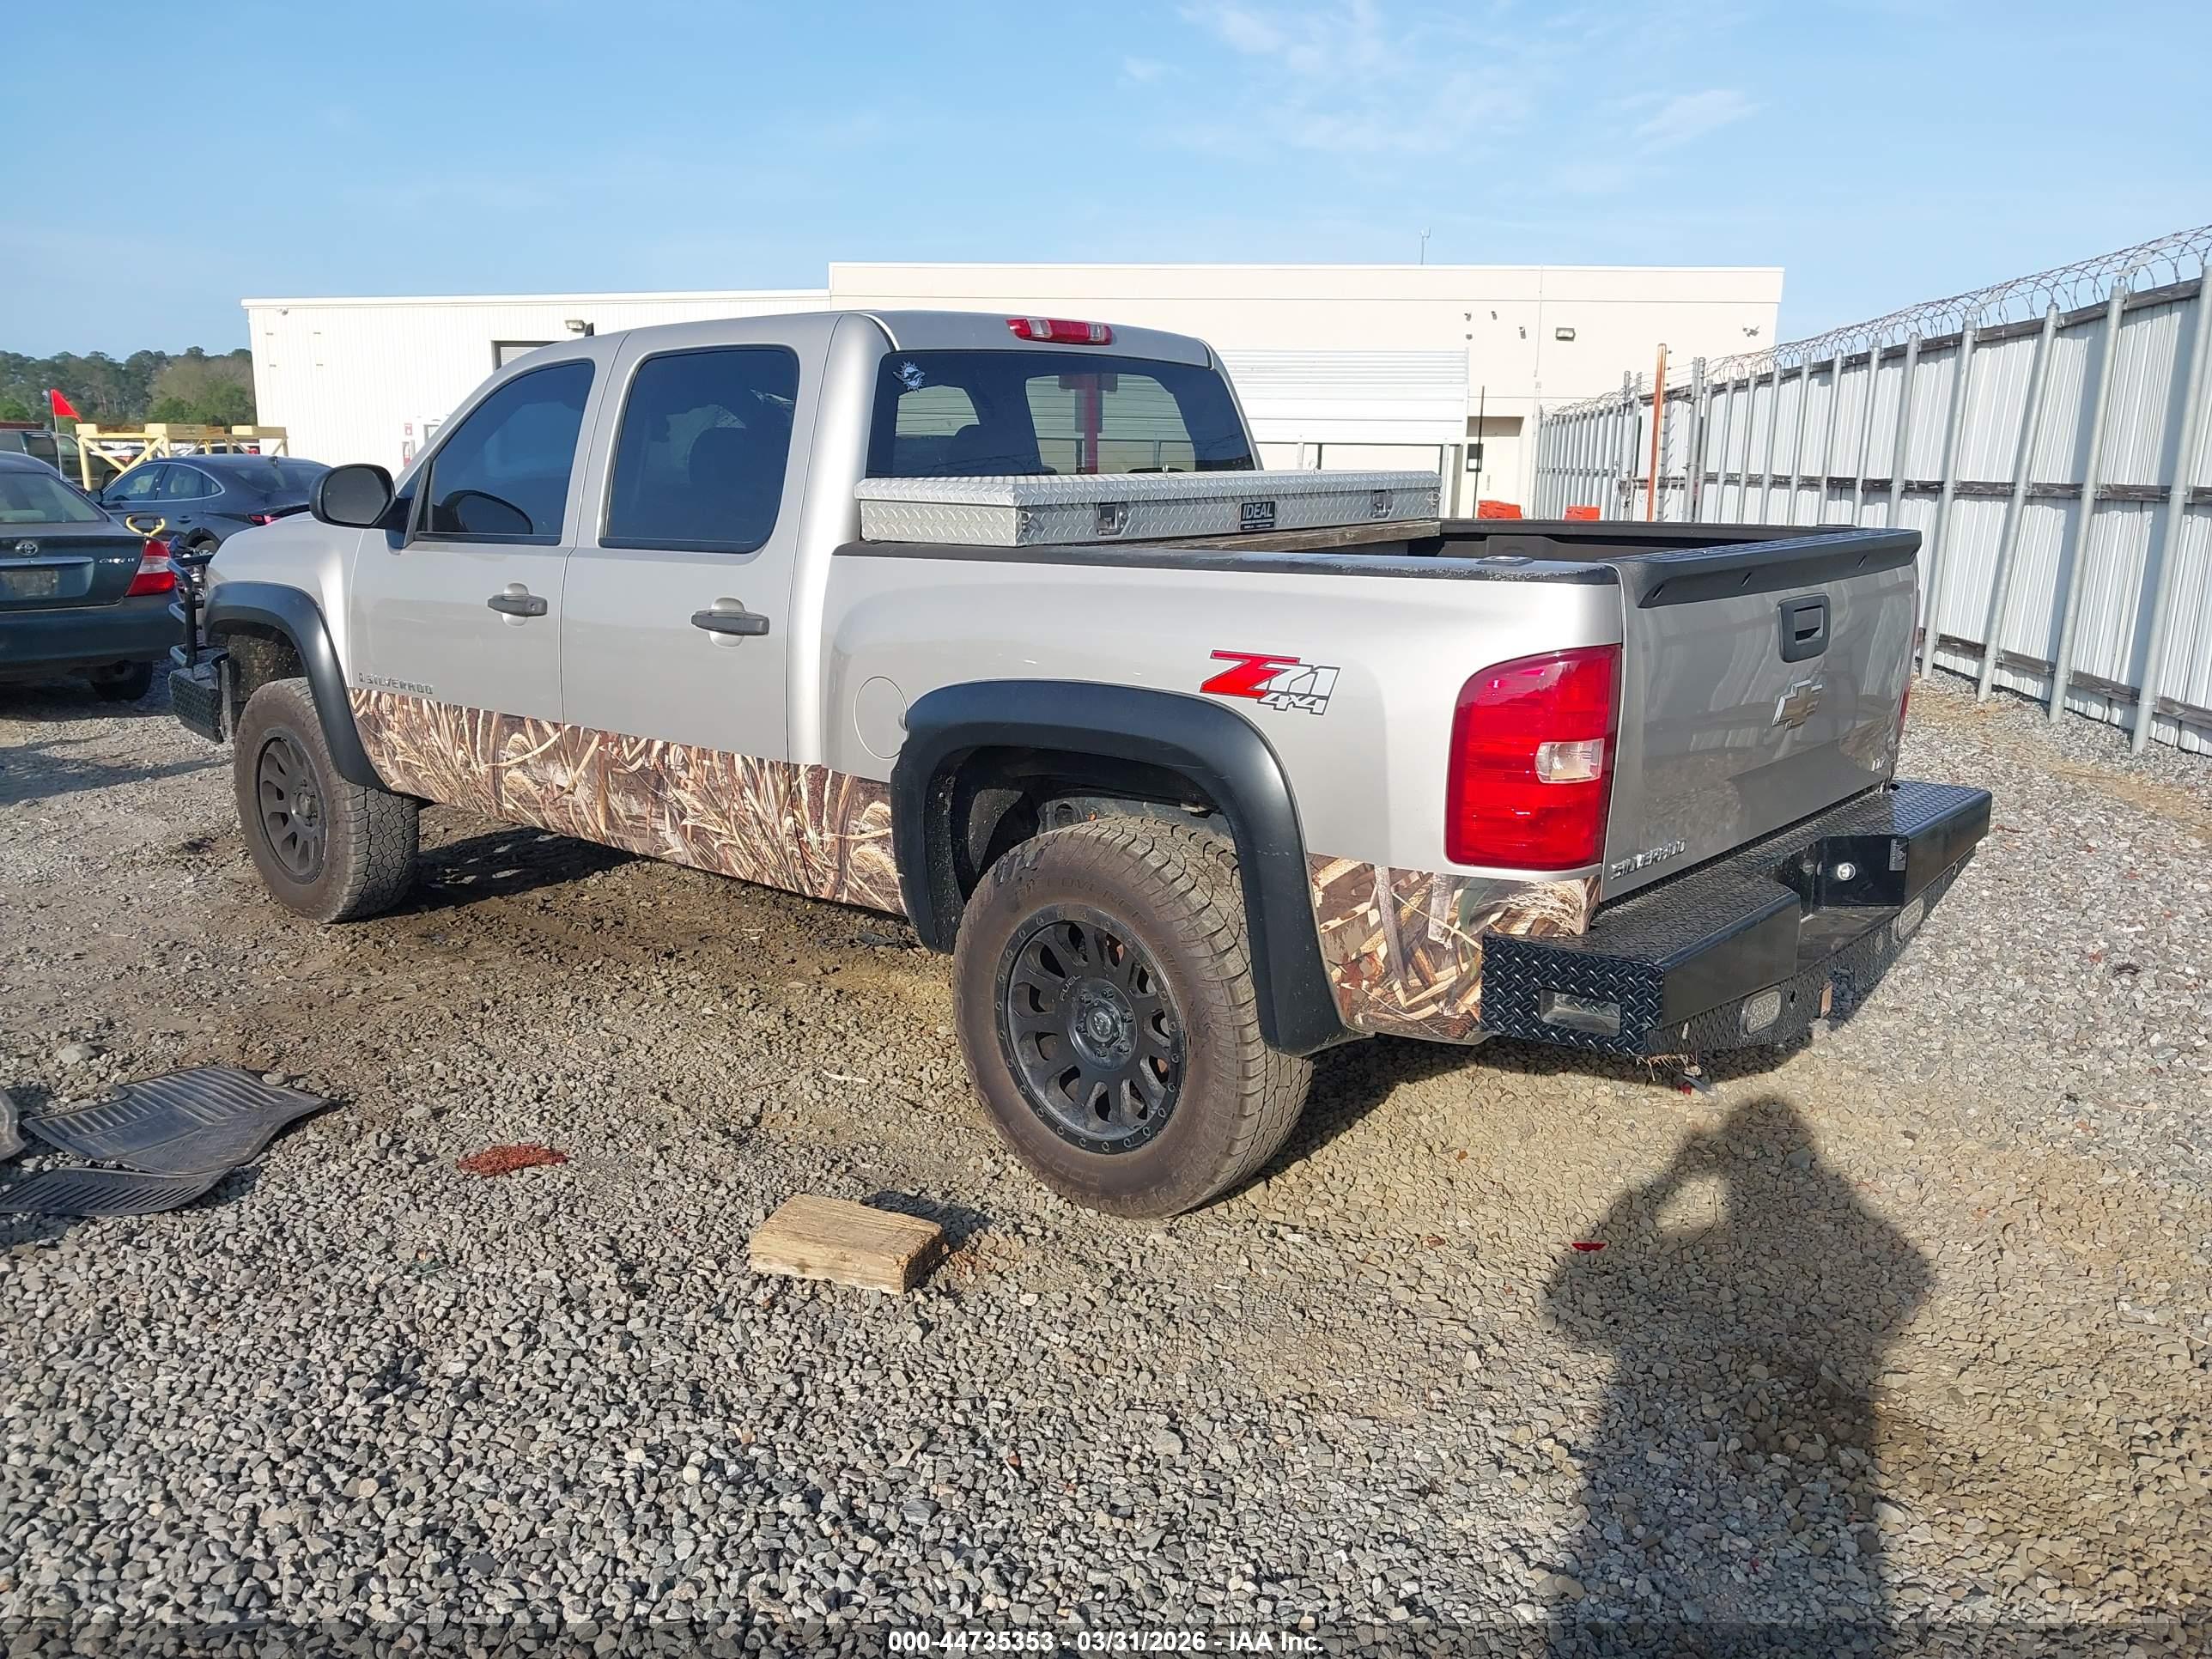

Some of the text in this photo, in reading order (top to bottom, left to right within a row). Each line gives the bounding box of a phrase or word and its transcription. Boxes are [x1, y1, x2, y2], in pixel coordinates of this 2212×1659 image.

[1243, 503, 1273, 520] IDEAL
[367, 674, 434, 694] SILVERADO
[1200, 650, 1340, 700] Z71
[1610, 839, 1686, 880] SILVERADO
[1059, 975, 1082, 1002] FUEL
